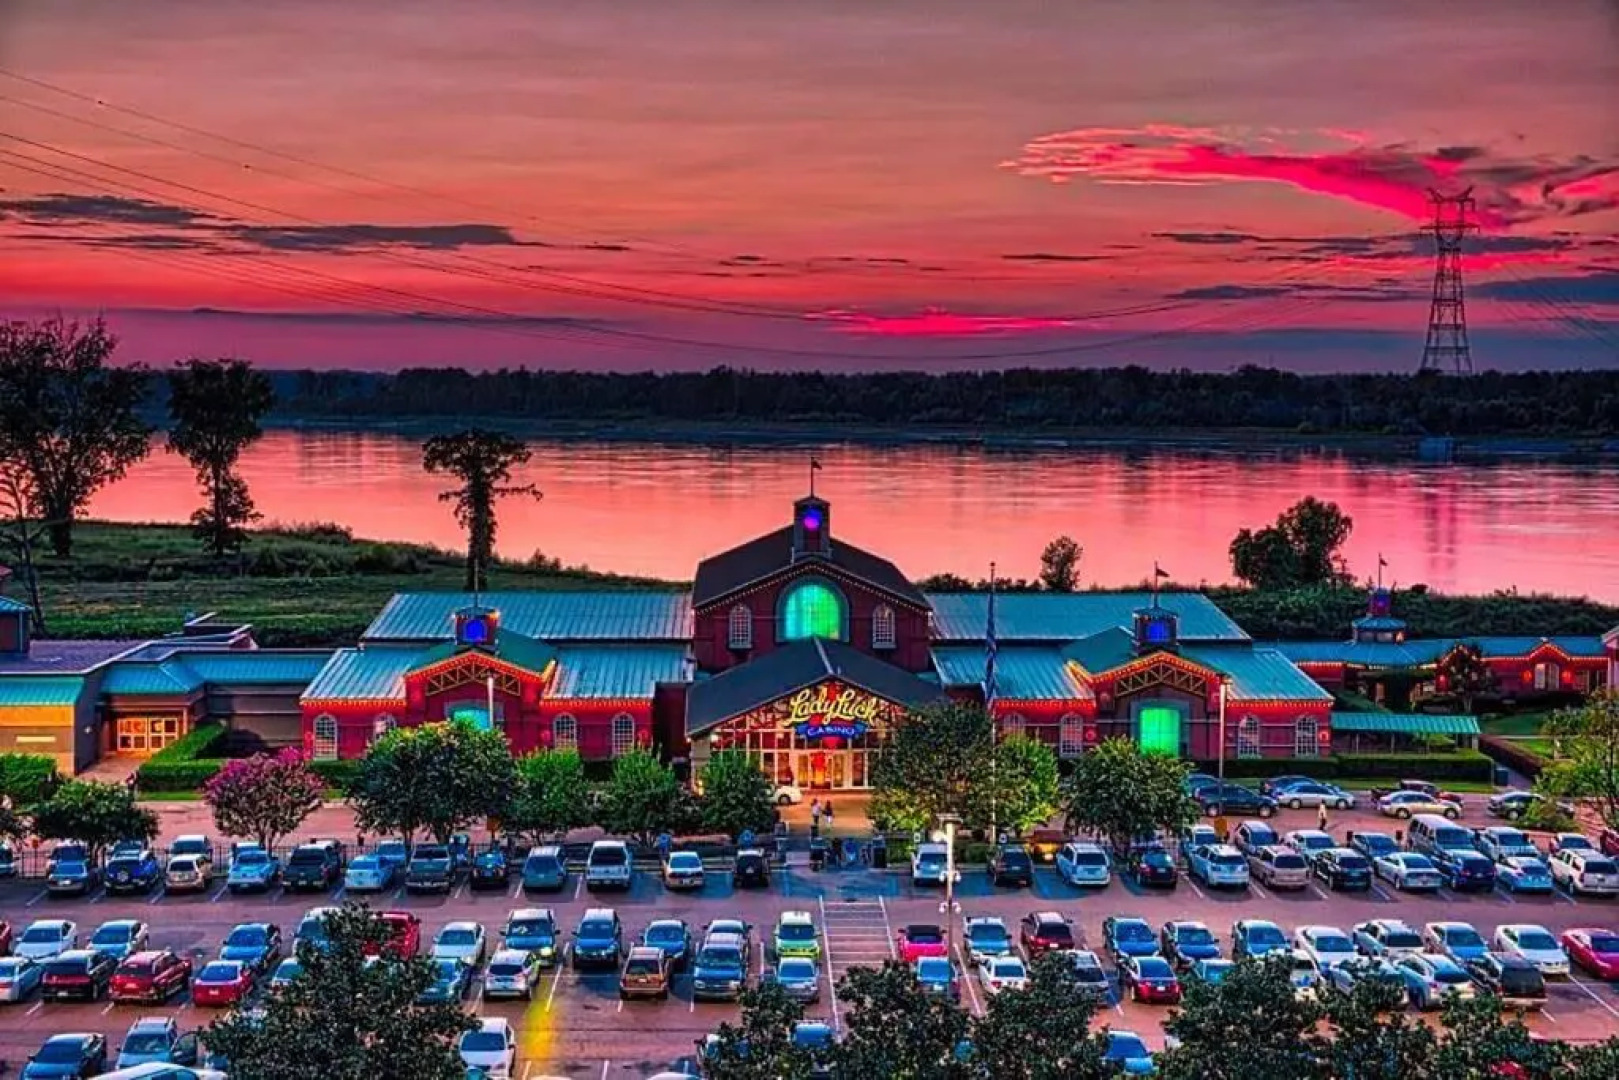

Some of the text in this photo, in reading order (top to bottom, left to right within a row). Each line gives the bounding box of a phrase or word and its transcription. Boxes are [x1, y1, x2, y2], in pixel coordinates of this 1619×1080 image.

[782, 688, 877, 726] Lady Luck
[807, 725, 855, 736] CASINO
